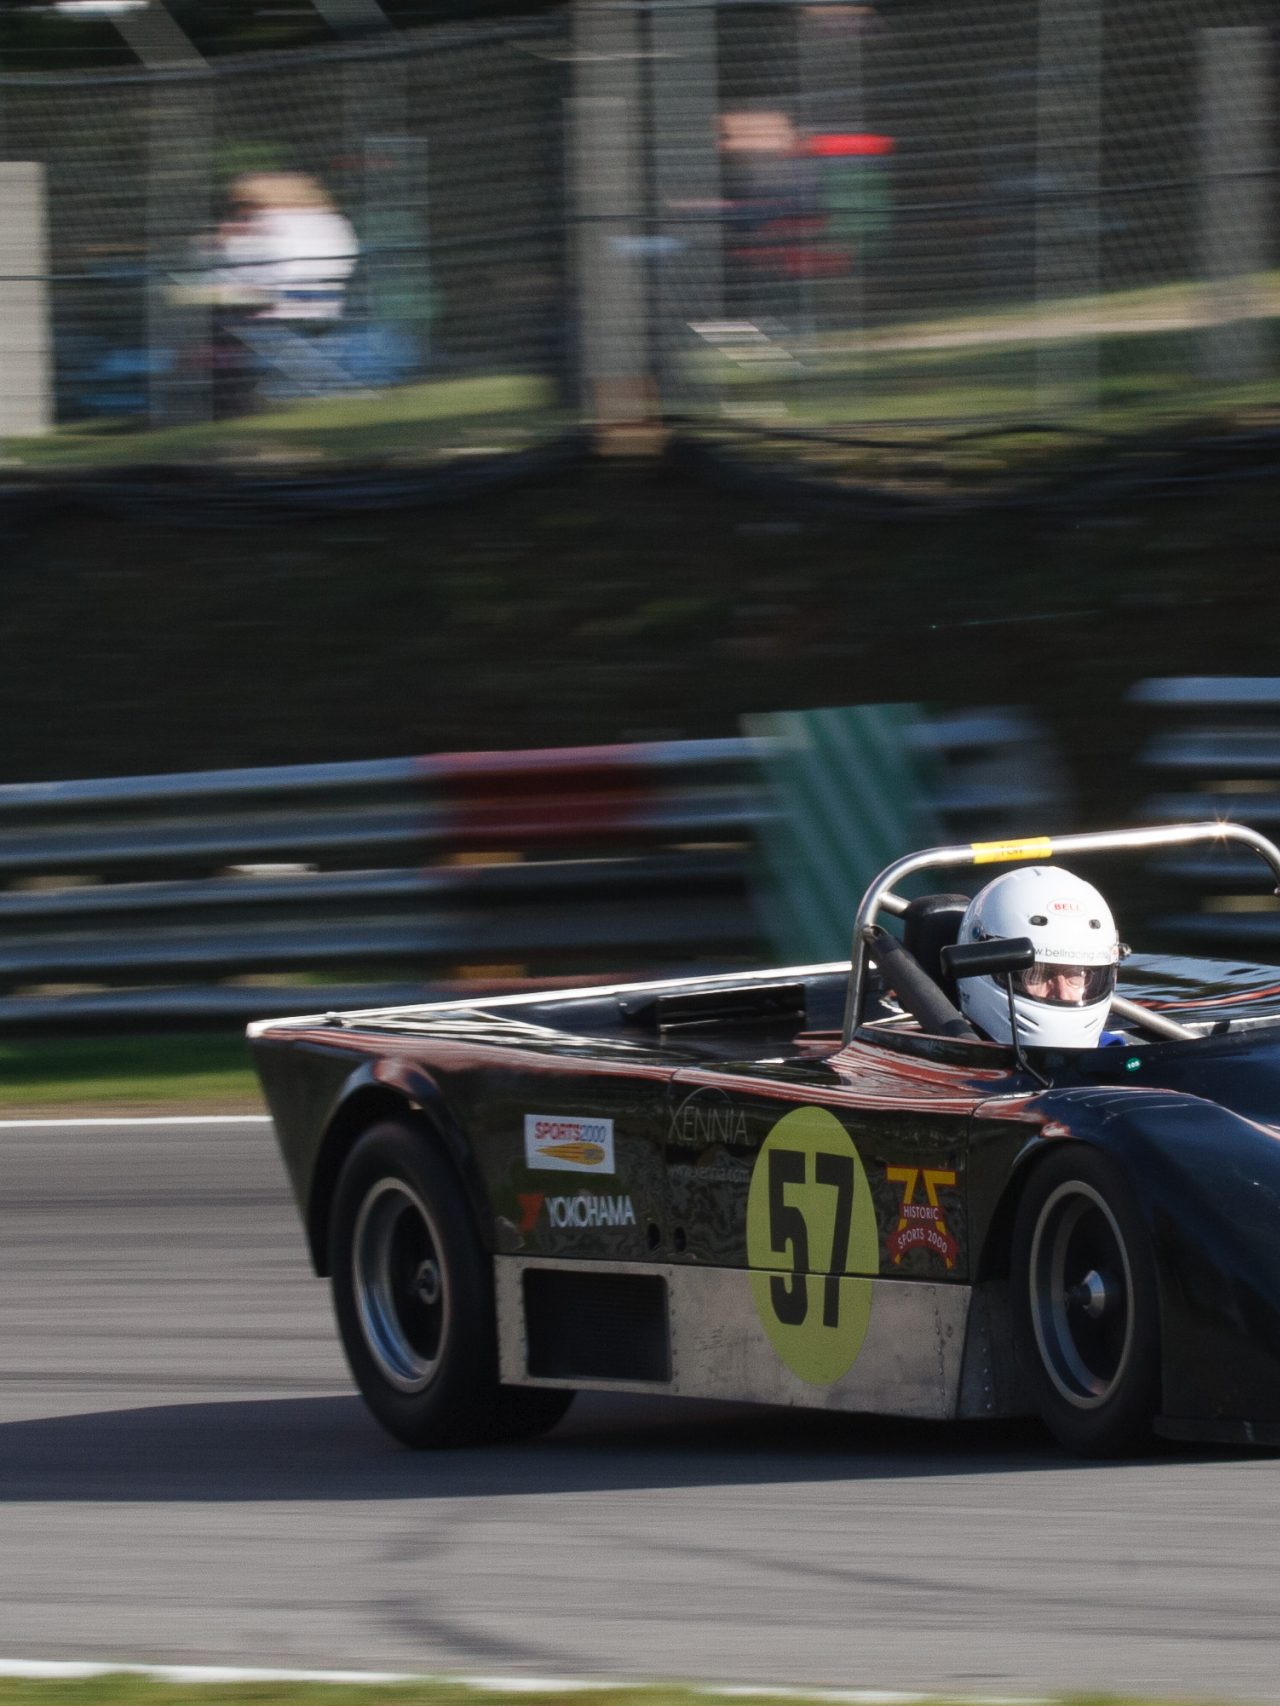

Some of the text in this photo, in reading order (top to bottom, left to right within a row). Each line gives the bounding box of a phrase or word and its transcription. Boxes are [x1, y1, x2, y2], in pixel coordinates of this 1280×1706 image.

[1054, 903, 1081, 913] BELL
[667, 1104, 751, 1146] XENNIA
[544, 1194, 637, 1228] YOKOHAMA
[903, 1205, 940, 1220] HISTORIC
[768, 1148, 854, 1328] 57
[897, 1227, 948, 1254] SPORTS 2000
